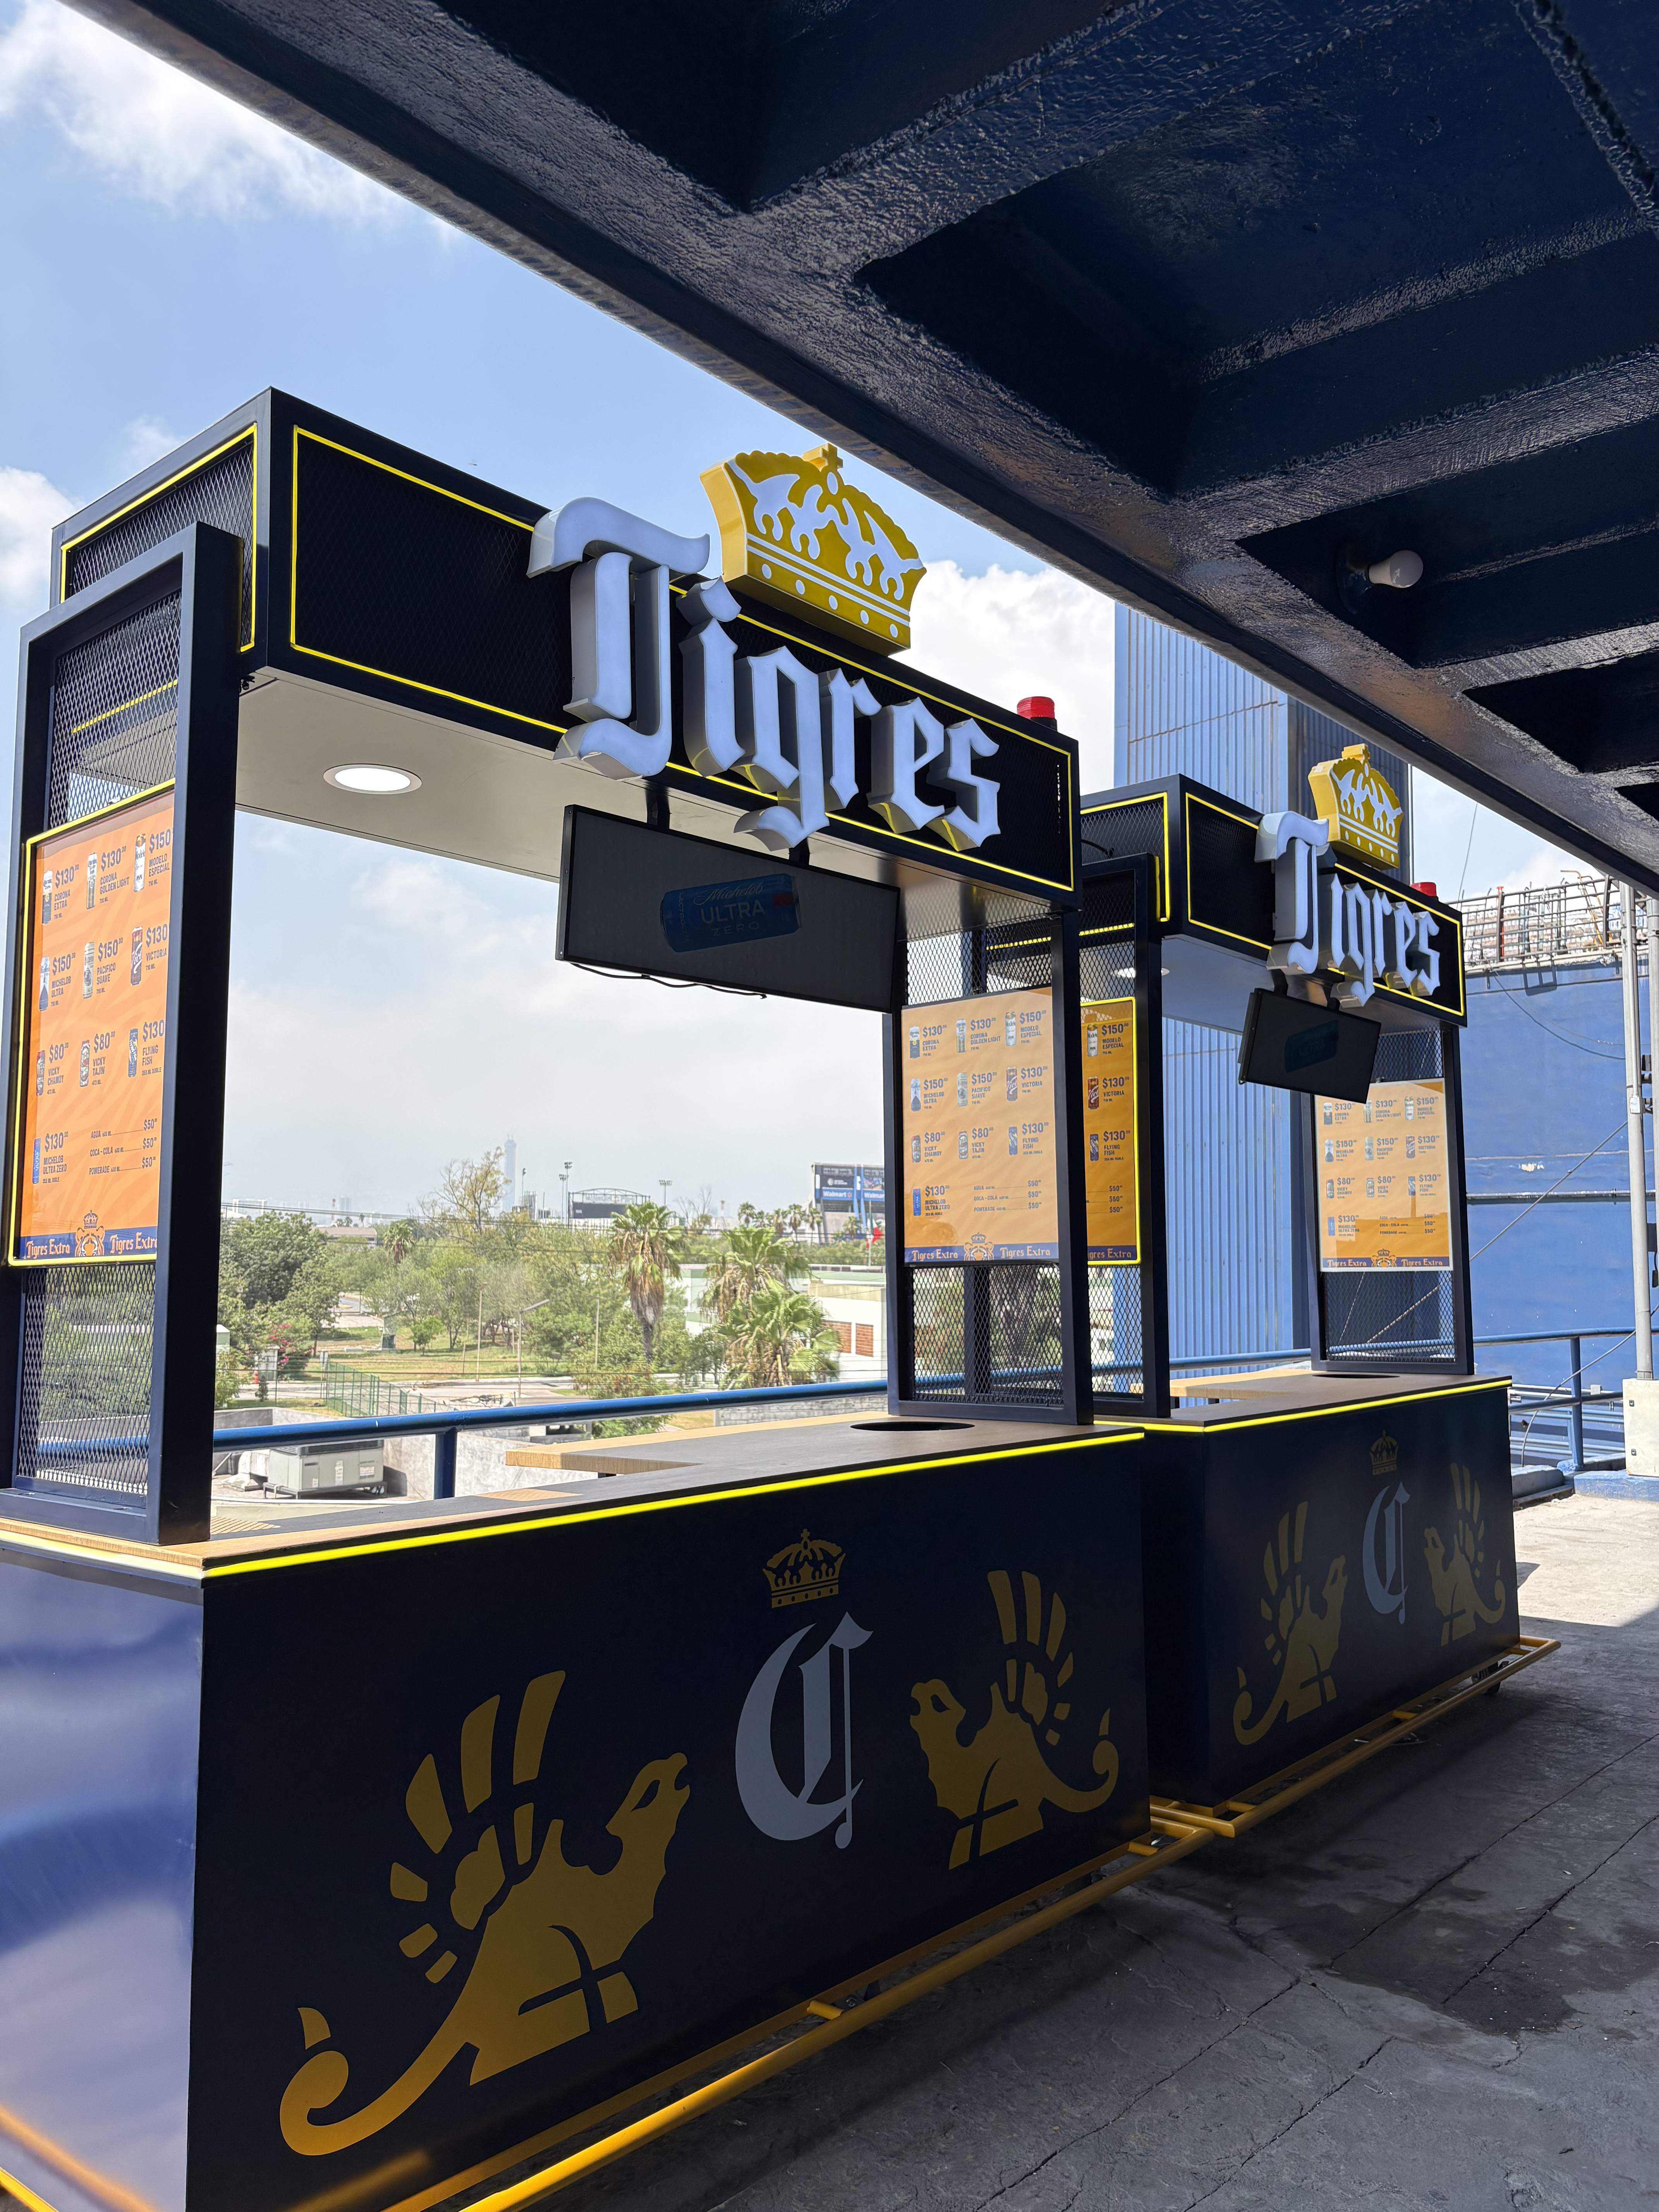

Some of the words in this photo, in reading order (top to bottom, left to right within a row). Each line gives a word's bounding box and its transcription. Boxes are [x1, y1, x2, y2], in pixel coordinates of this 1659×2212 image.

[528, 497, 1000, 851] Tigres
[149, 854, 167, 867] MODELO
[149, 863, 170, 877] ESPECIAL
[100, 872, 117, 885] CORONA
[100, 883, 115, 894] GOLDEN
[117, 877, 130, 888] LIGHT
[55, 890, 70, 901] CORONA
[54, 900, 67, 910] EXTRA
[1255, 811, 1440, 1007] Tigres
[701, 900, 766, 924] ULTRA
[712, 921, 760, 936] ZERO
[146, 948, 167, 961] VICTORIA
[97, 963, 115, 975] PACIFICO
[52, 976, 71, 989] MICHELOB
[97, 974, 110, 985] SUAVE
[52, 988, 64, 998] ULTRA
[143, 1045, 158, 1056] FLYING
[93, 1056, 106, 1066] VICKY
[143, 1056, 152, 1066] FISH
[48, 1066, 60, 1077] VICKY
[48, 1075, 64, 1085] CHAMOY
[91, 1130, 101, 1139] AGUA
[43, 1155, 63, 1165] MICHELOB
[43, 1166, 56, 1174] ULTRA
[57, 1164, 67, 1173] ZERO
[89, 1166, 109, 1175] POWERADE
[26, 1240, 47, 1259] Tigres
[49, 1238, 70, 1255] Extra
[110, 1235, 133, 1254] Tigres
[912, 1250, 934, 1262] Tigres
[936, 1249, 958, 1259] Extra
[1000, 1247, 1024, 1259] Tigres
[1026, 1246, 1050, 1256] Extra
[1107, 1249, 1131, 1258] Extra
